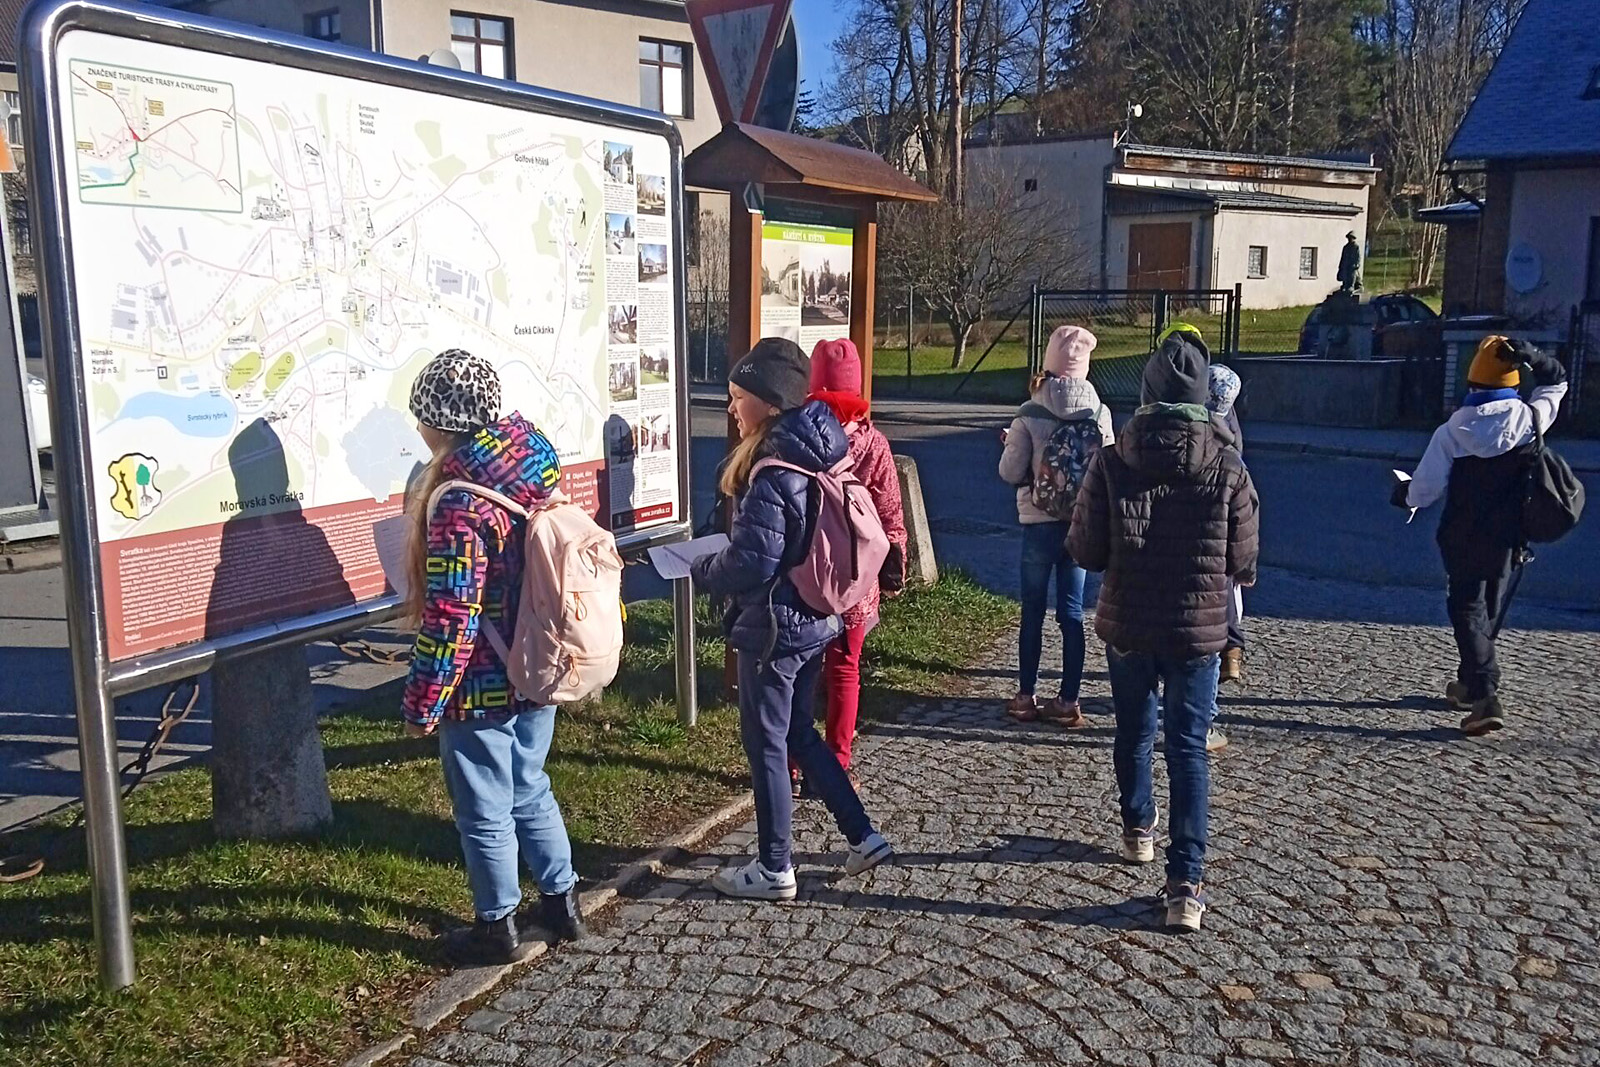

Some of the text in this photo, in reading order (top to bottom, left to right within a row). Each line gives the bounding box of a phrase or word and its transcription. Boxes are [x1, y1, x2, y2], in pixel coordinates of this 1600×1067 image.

[87, 67, 117, 79] ZNAČENÉ
[118, 72, 154, 85] TURISTICKÉ
[155, 78, 175, 87] TRASY
[180, 82, 218, 94] CYKLOTRASY
[514, 324, 555, 336] Česká Cikánka
[90, 349, 113, 357] Hlinsko
[187, 411, 228, 423] Svratecký rybník
[219, 491, 304, 513] Moravská Svratka
